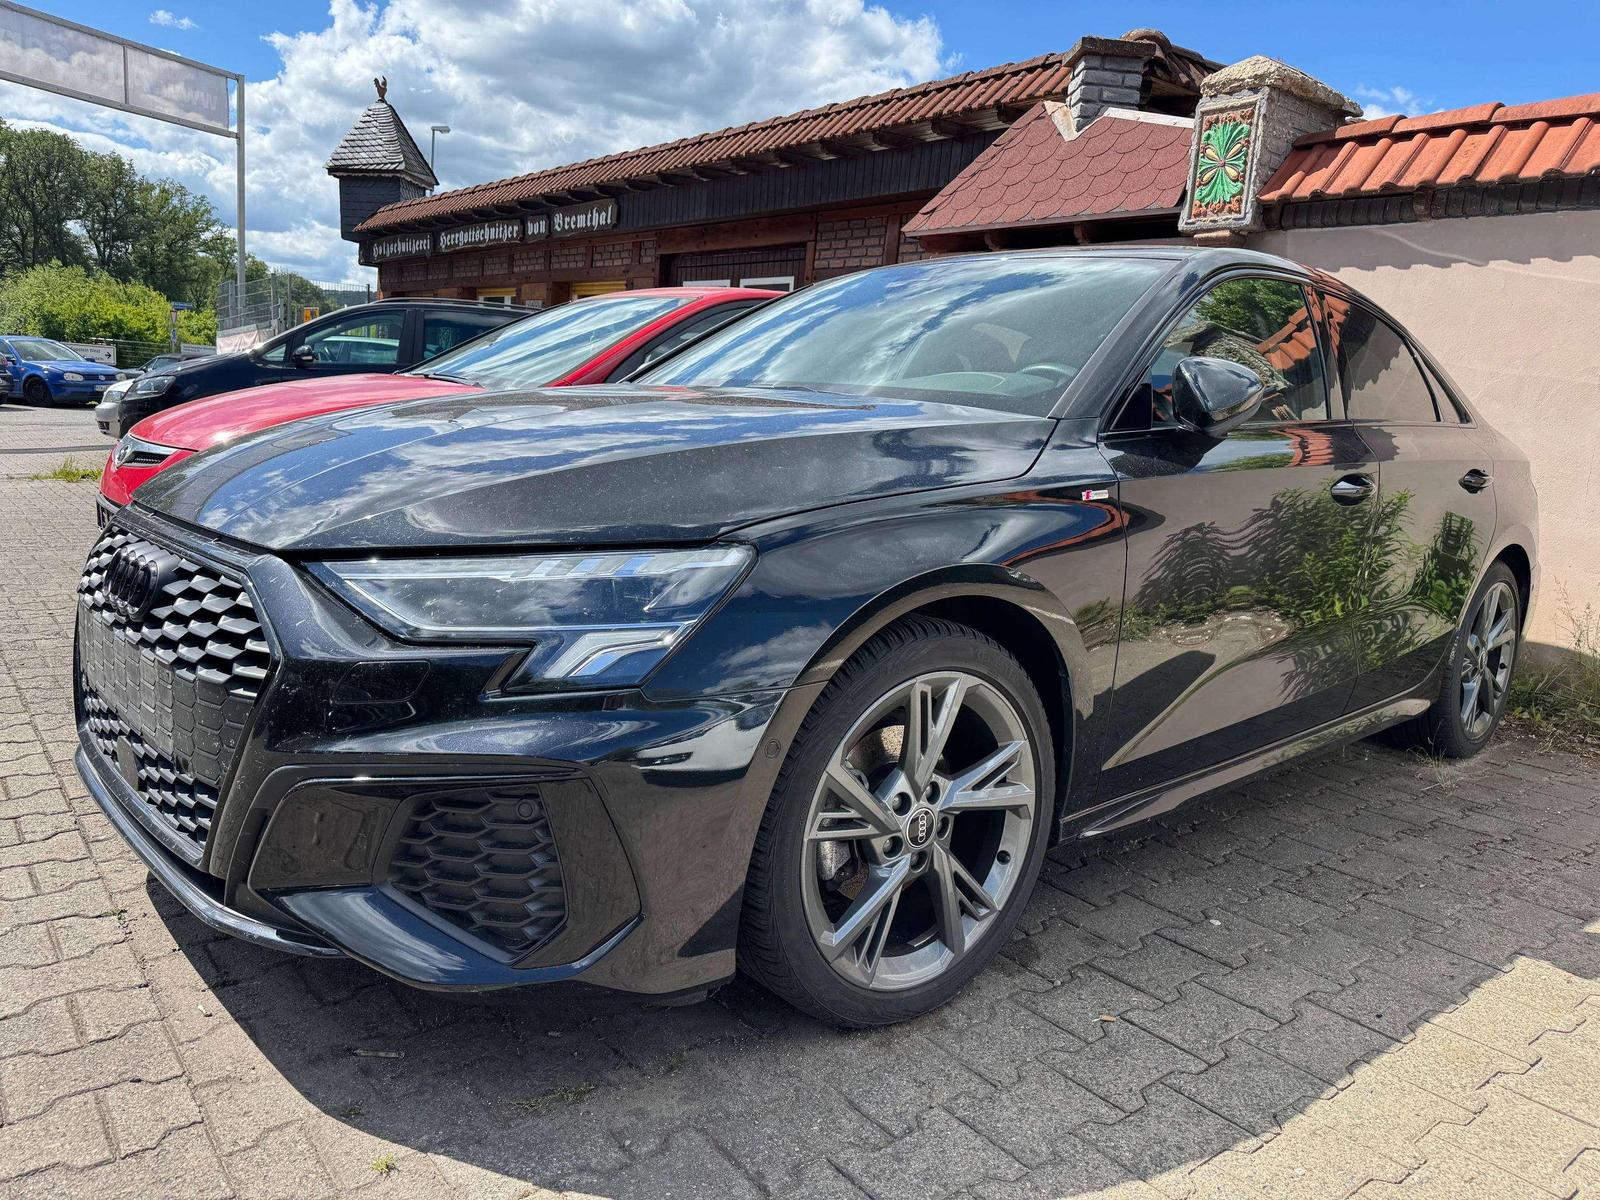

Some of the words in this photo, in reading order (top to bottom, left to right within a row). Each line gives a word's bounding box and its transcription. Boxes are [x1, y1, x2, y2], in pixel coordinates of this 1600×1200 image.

[440, 223, 519, 248] Herrgottschnitzer
[527, 219, 546, 235] von
[553, 204, 613, 231] Bremthal
[373, 235, 430, 260] Holzschnitzerei
